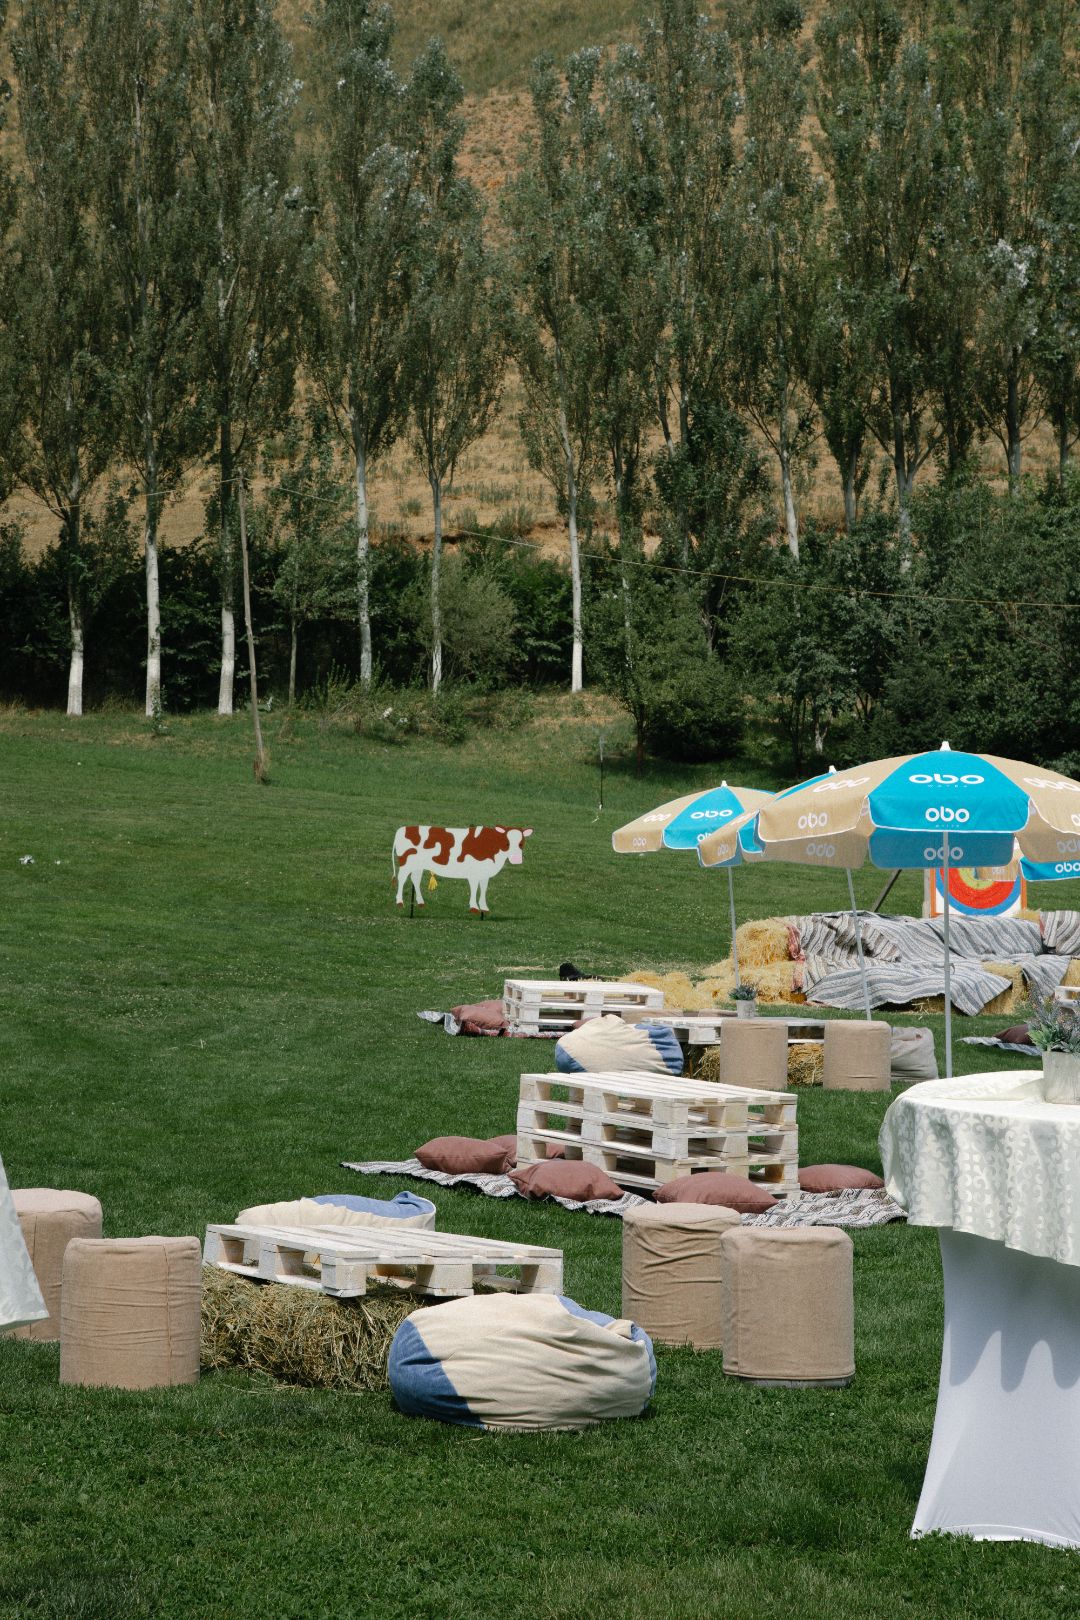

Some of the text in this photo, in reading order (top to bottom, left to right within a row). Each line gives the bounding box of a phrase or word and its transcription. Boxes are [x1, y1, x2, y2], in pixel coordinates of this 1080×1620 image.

[909, 773, 985, 785] obo
[691, 810, 733, 819] obo
[798, 812, 828, 829] obo
[925, 806, 970, 823] obo
[1055, 862, 1080, 873] obo
